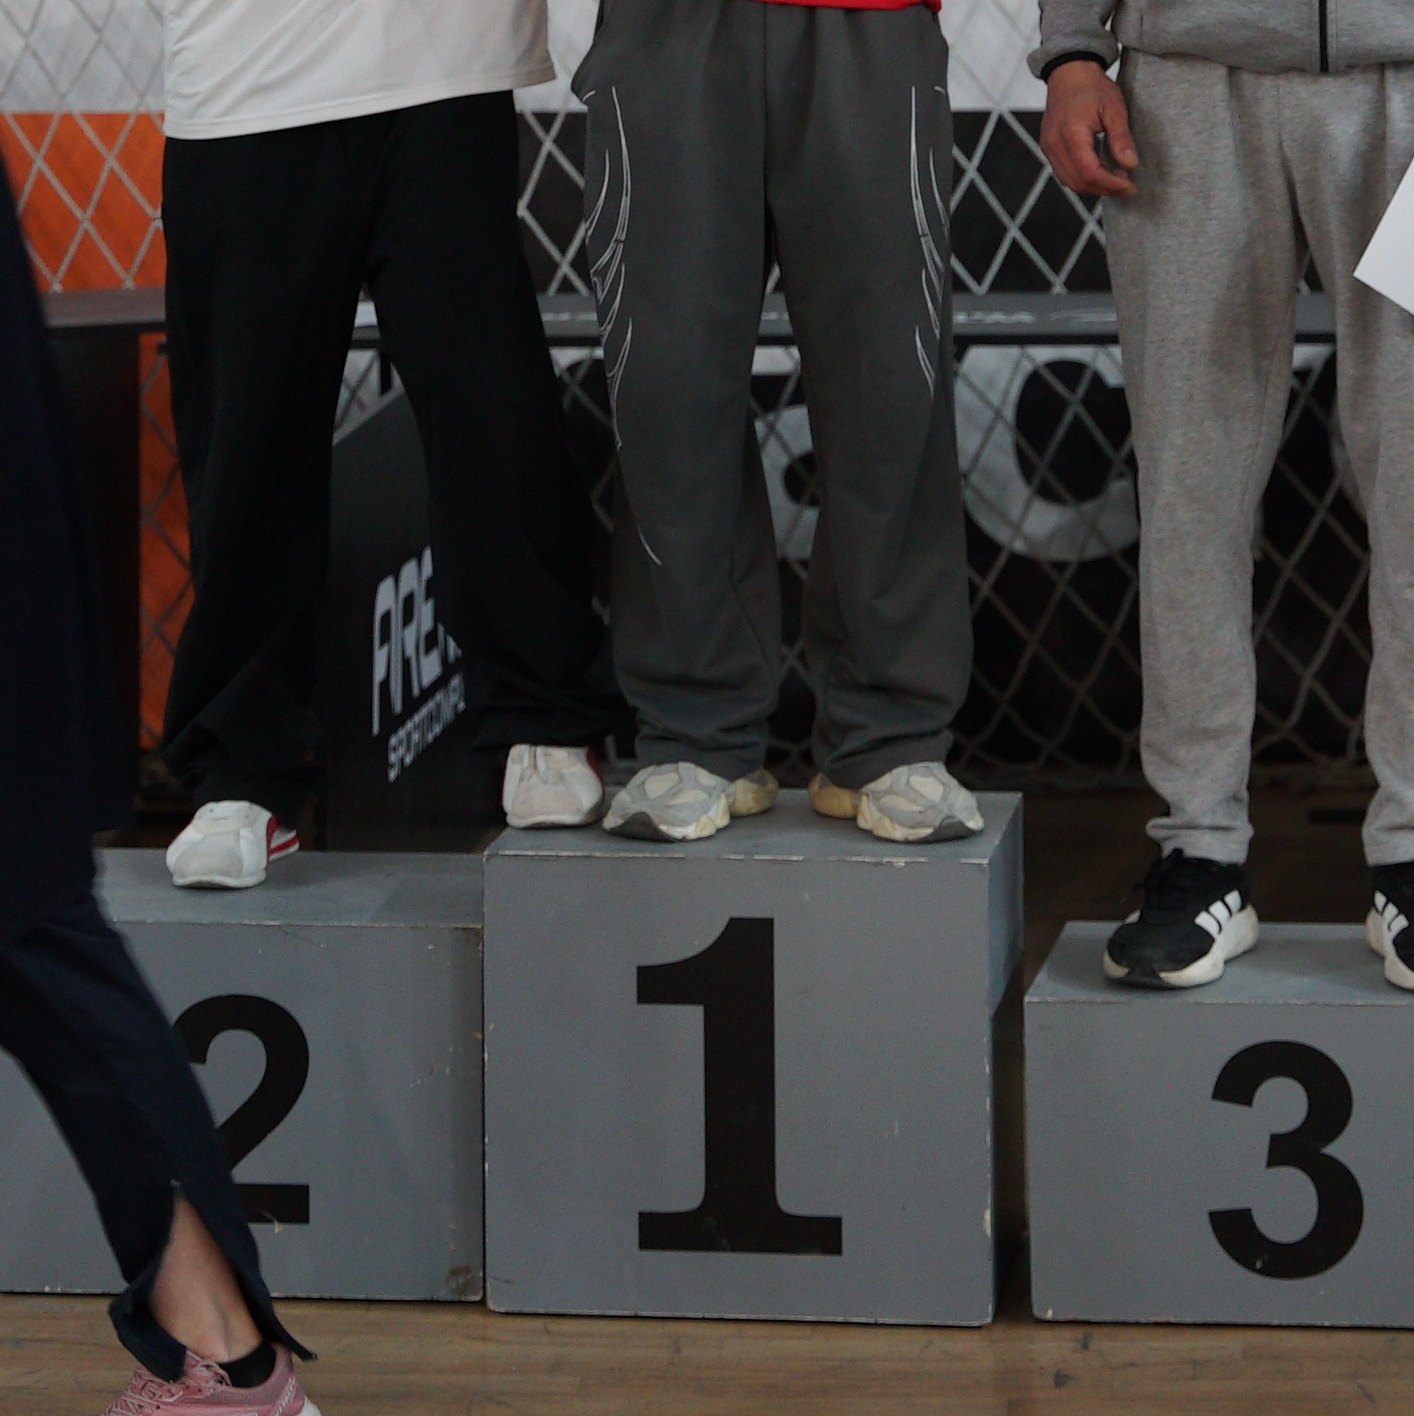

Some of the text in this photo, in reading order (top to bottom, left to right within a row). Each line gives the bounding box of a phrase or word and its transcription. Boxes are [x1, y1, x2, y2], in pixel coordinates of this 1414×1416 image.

[173, 994, 310, 1225] 2
[636, 915, 844, 1258] 1
[1207, 1039, 1366, 1280] 3
